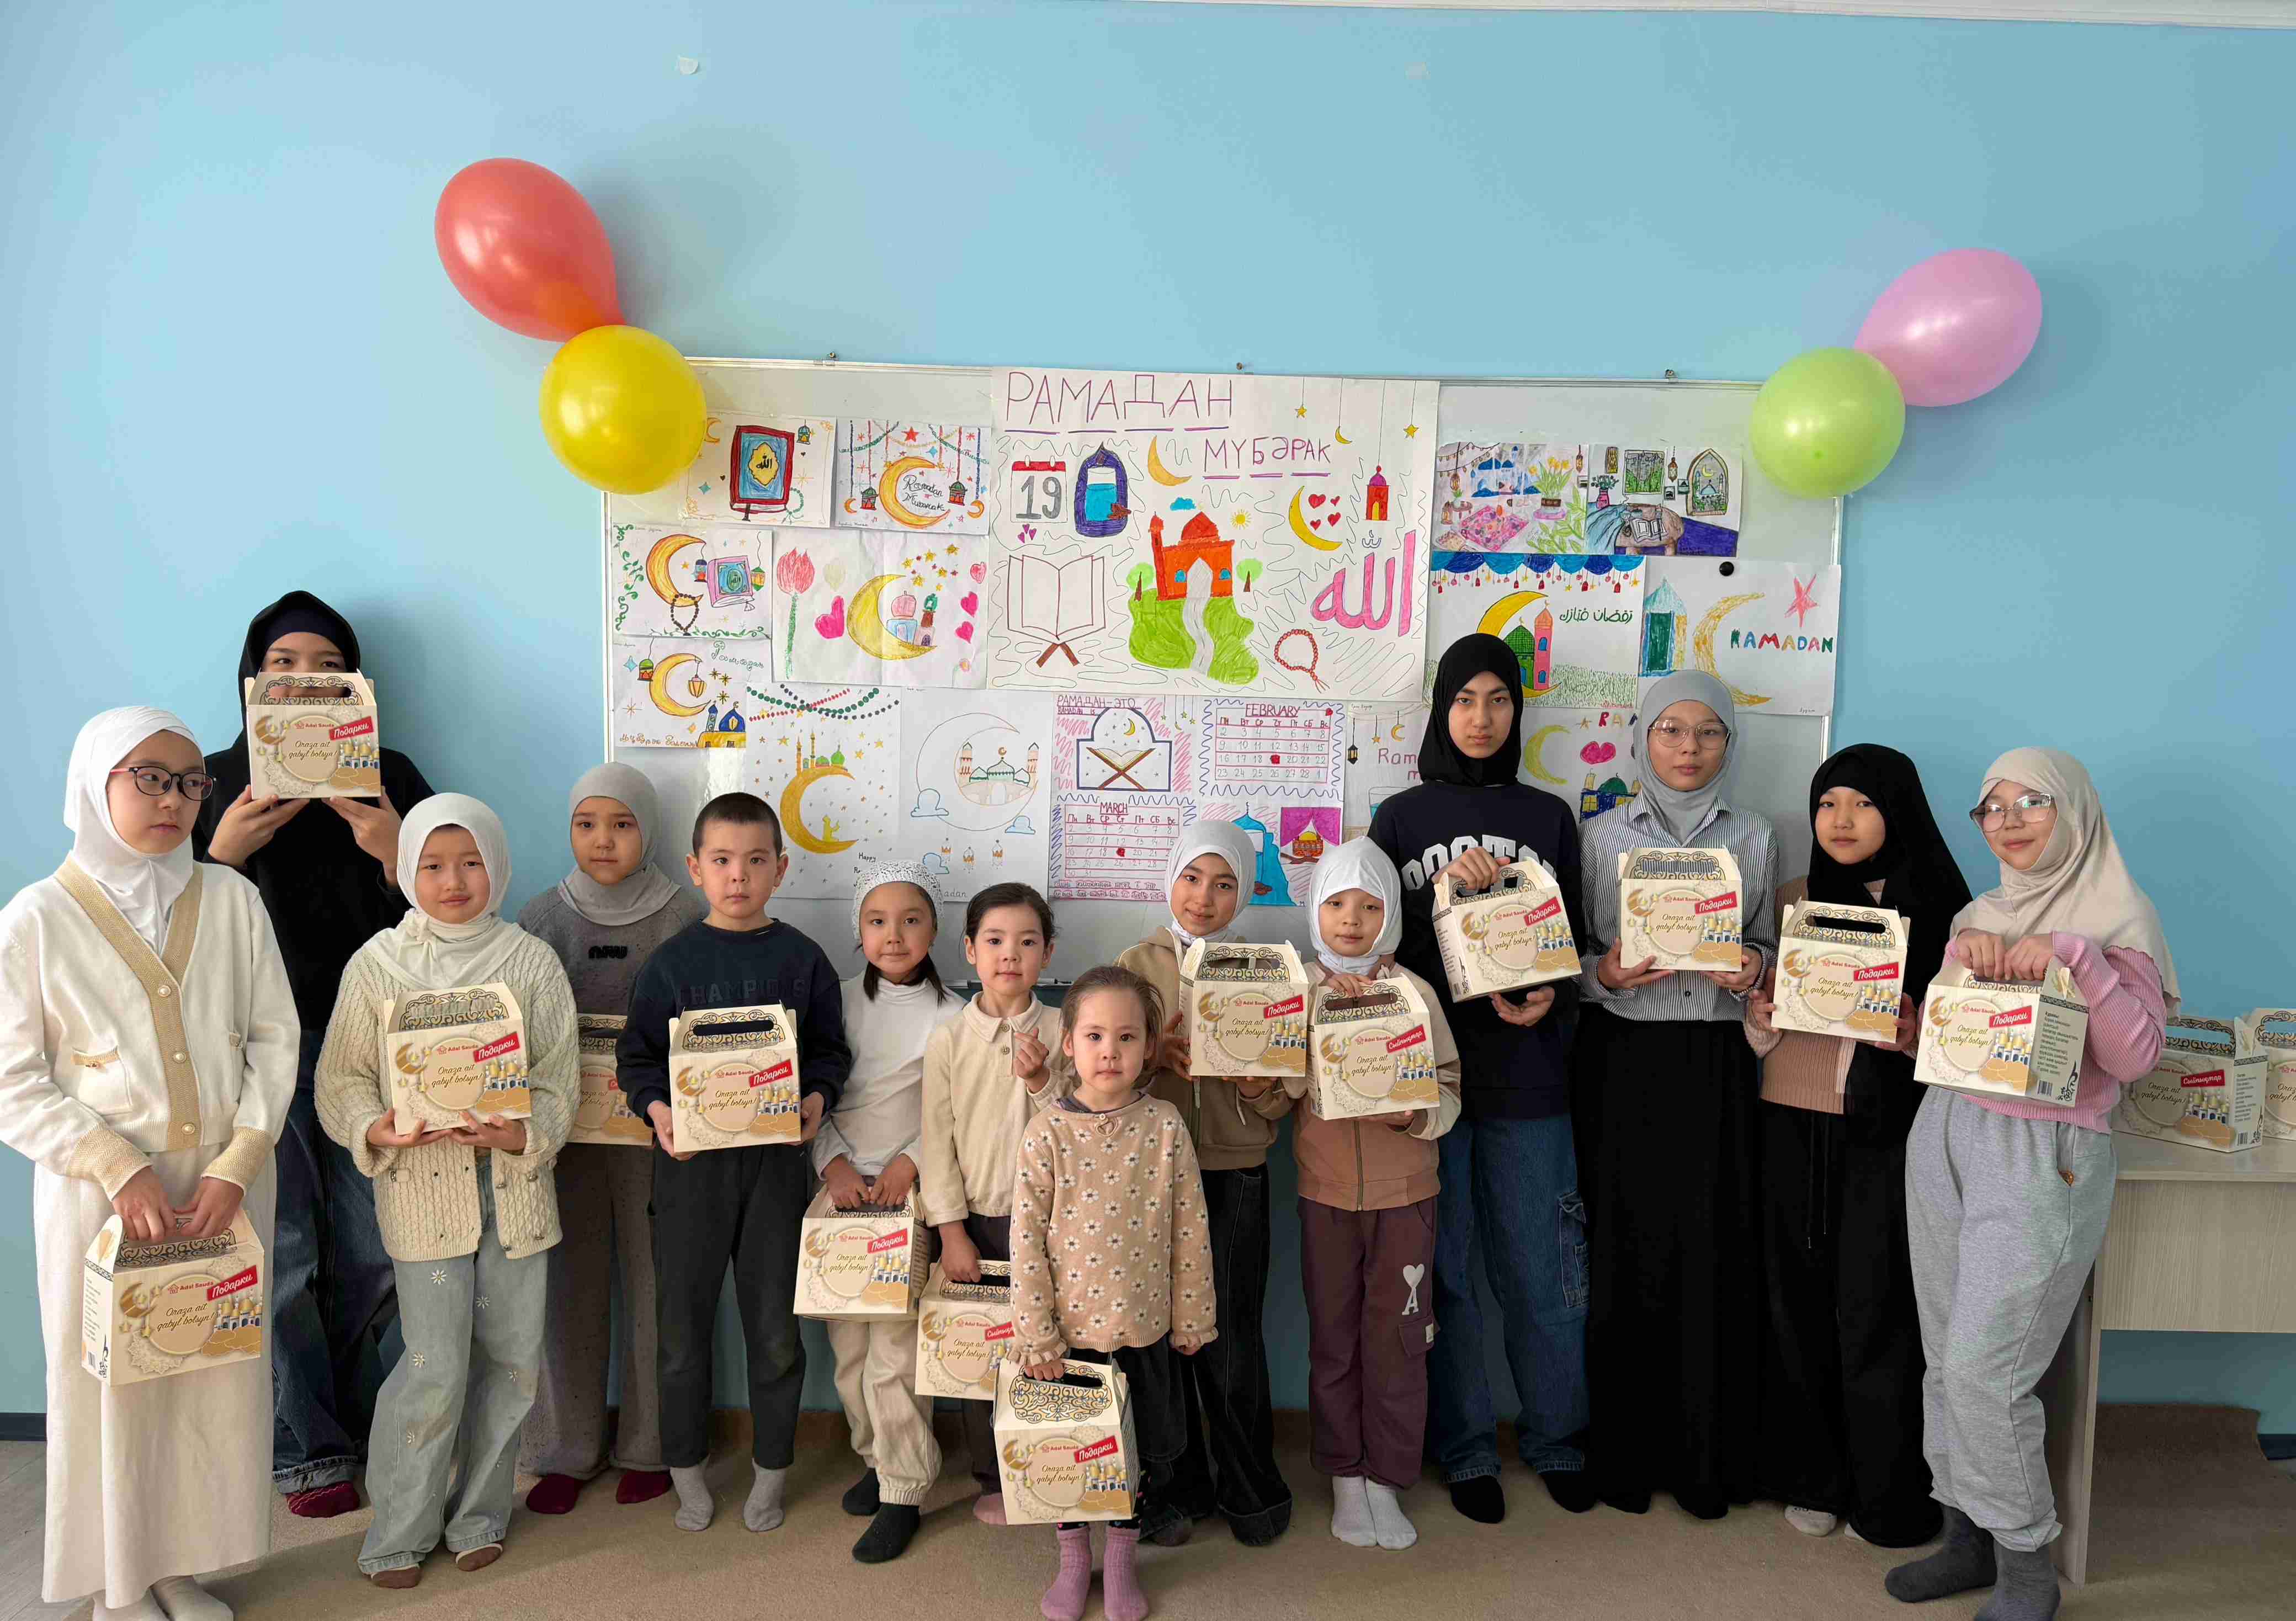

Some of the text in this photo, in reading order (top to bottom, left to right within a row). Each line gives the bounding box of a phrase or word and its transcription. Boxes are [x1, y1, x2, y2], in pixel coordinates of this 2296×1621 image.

[1006, 371, 1233, 425] РАМАДАН
[1203, 437, 1331, 472] МҮБӘРАК
[903, 475, 943, 497] Ramadan
[1016, 476, 1061, 520] 19
[1731, 629, 1833, 652] RAMADAN
[1245, 704, 1300, 717] FEBRUARY
[334, 724, 369, 737] Подарки
[295, 741, 318, 750] Oraza
[1099, 802, 1129, 814] MARCH
[859, 852, 876, 863] Happy
[1699, 899, 1732, 911] Подарки
[1529, 904, 1556, 922] Подарки
[1662, 914, 1684, 923] Oraza
[1858, 968, 1894, 979] Подарки
[1819, 977, 1840, 988] Oraza
[1268, 1000, 1300, 1016] Подарки
[1232, 1018, 1252, 1027] Oraza
[1994, 1011, 2027, 1025] Подарки
[1957, 1024, 1977, 1033] Oraza
[479, 1039, 515, 1059] Подарки
[1357, 1056, 1378, 1064] Oraza
[438, 1066, 461, 1077] Oraza
[754, 1067, 788, 1084] Подарки
[2148, 1082, 2169, 1093] Oraza
[716, 1090, 737, 1099] Oraza
[872, 1236, 903, 1251] Подарки
[213, 1274, 253, 1297] Подарки
[166, 1306, 192, 1316] Oraza
[954, 1338, 974, 1349] Oraza
[1079, 1442, 1113, 1460] Подарки
[1043, 1465, 1064, 1473] Oraza
